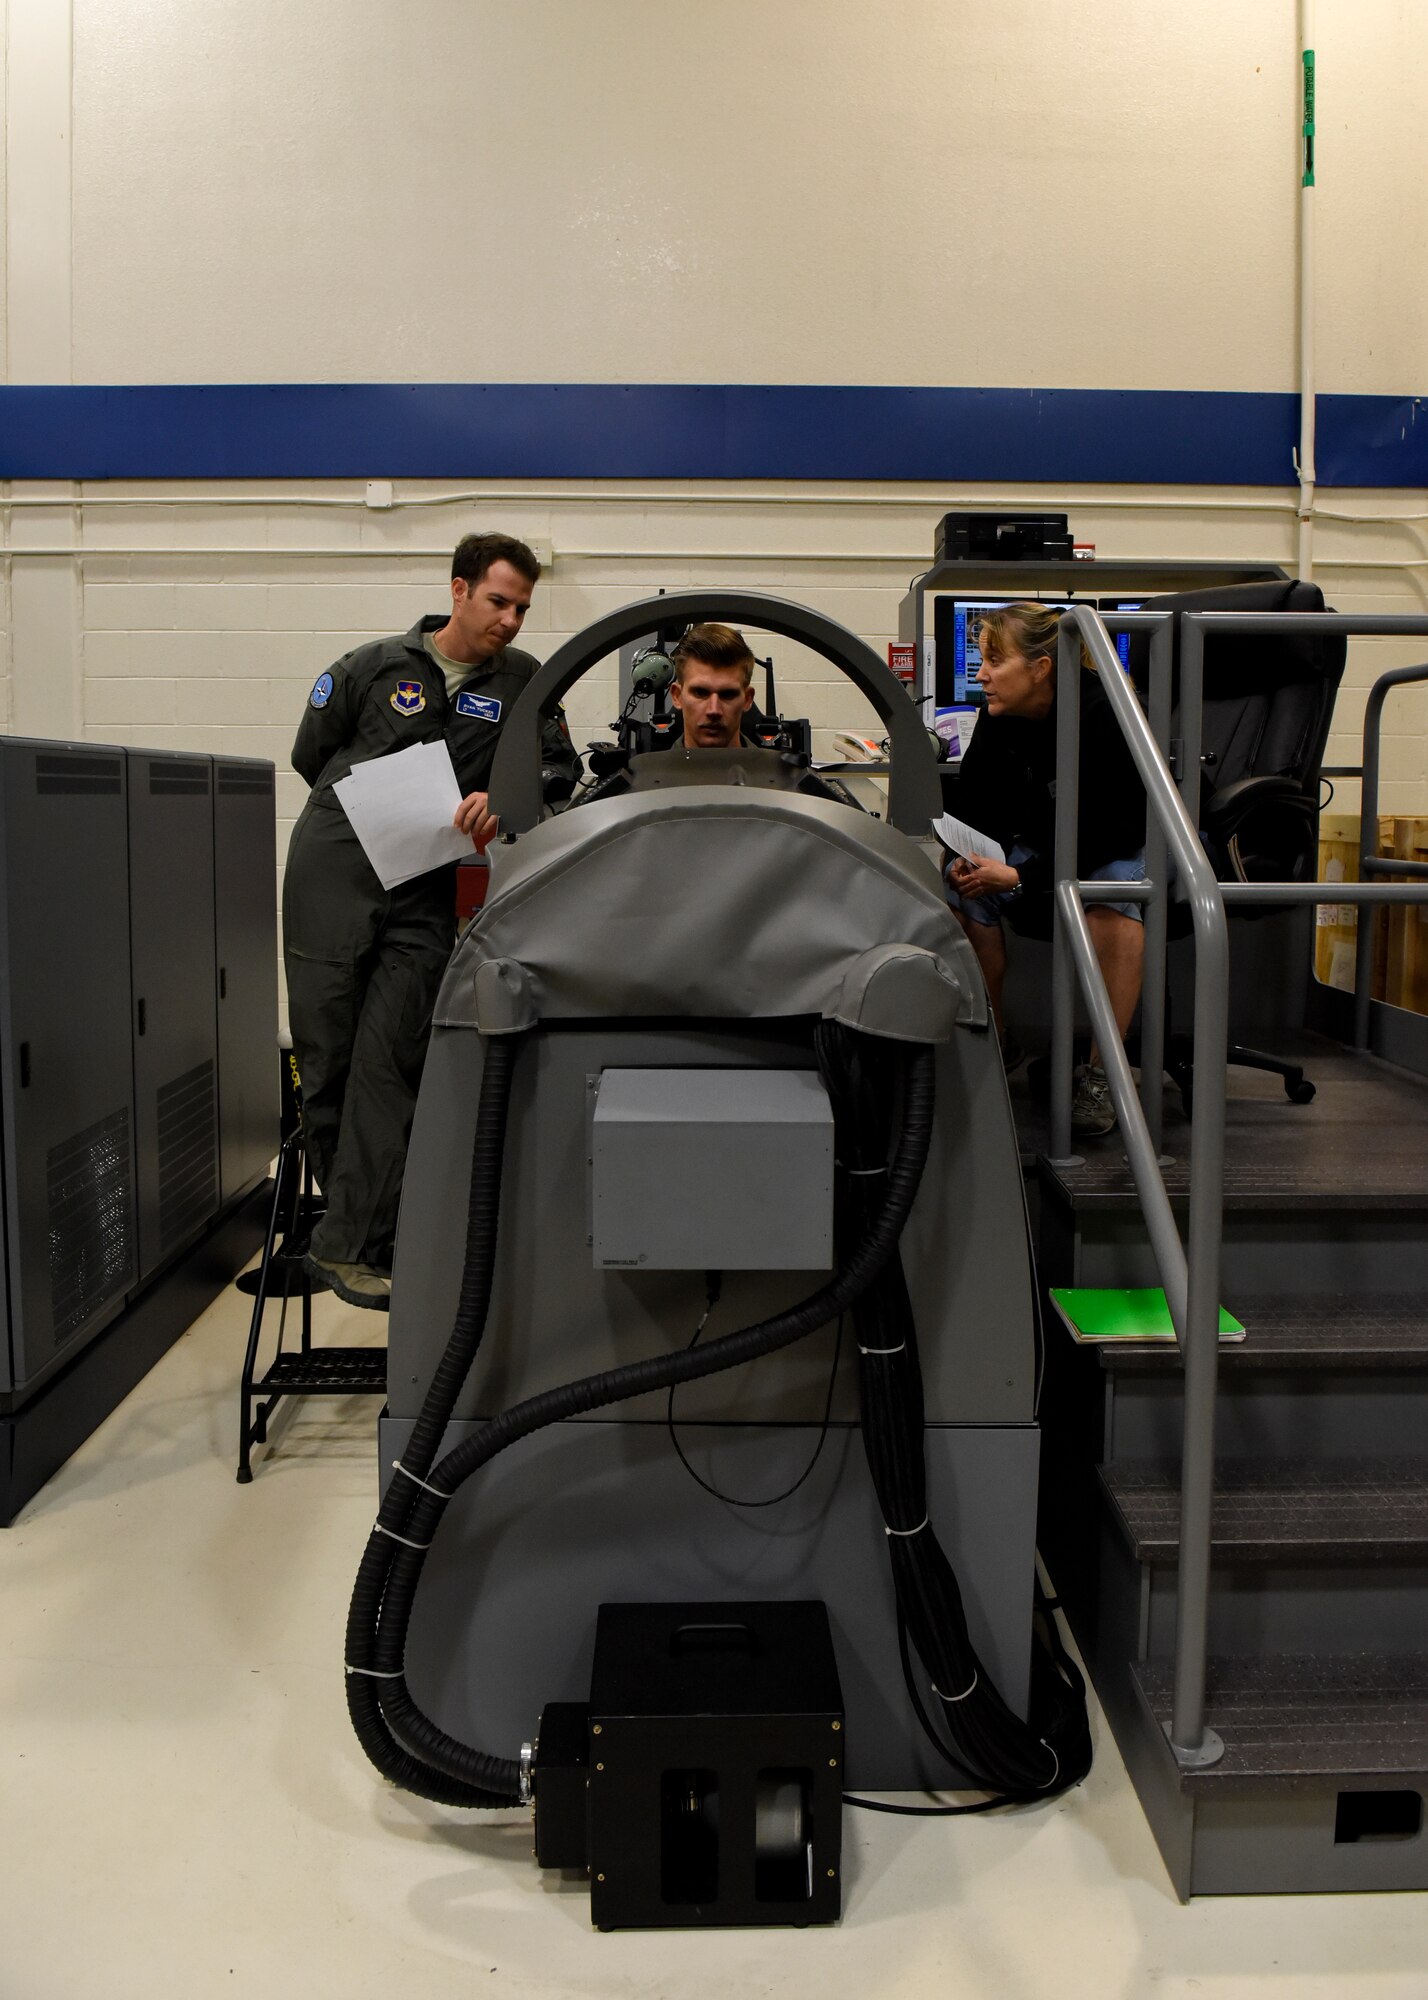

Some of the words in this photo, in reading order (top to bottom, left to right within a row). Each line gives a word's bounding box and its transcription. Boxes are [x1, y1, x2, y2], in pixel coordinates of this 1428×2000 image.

[1305, 66, 1314, 97] POTABLE
[1305, 100, 1314, 124] WATER
[893, 655, 913, 663] FIRE
